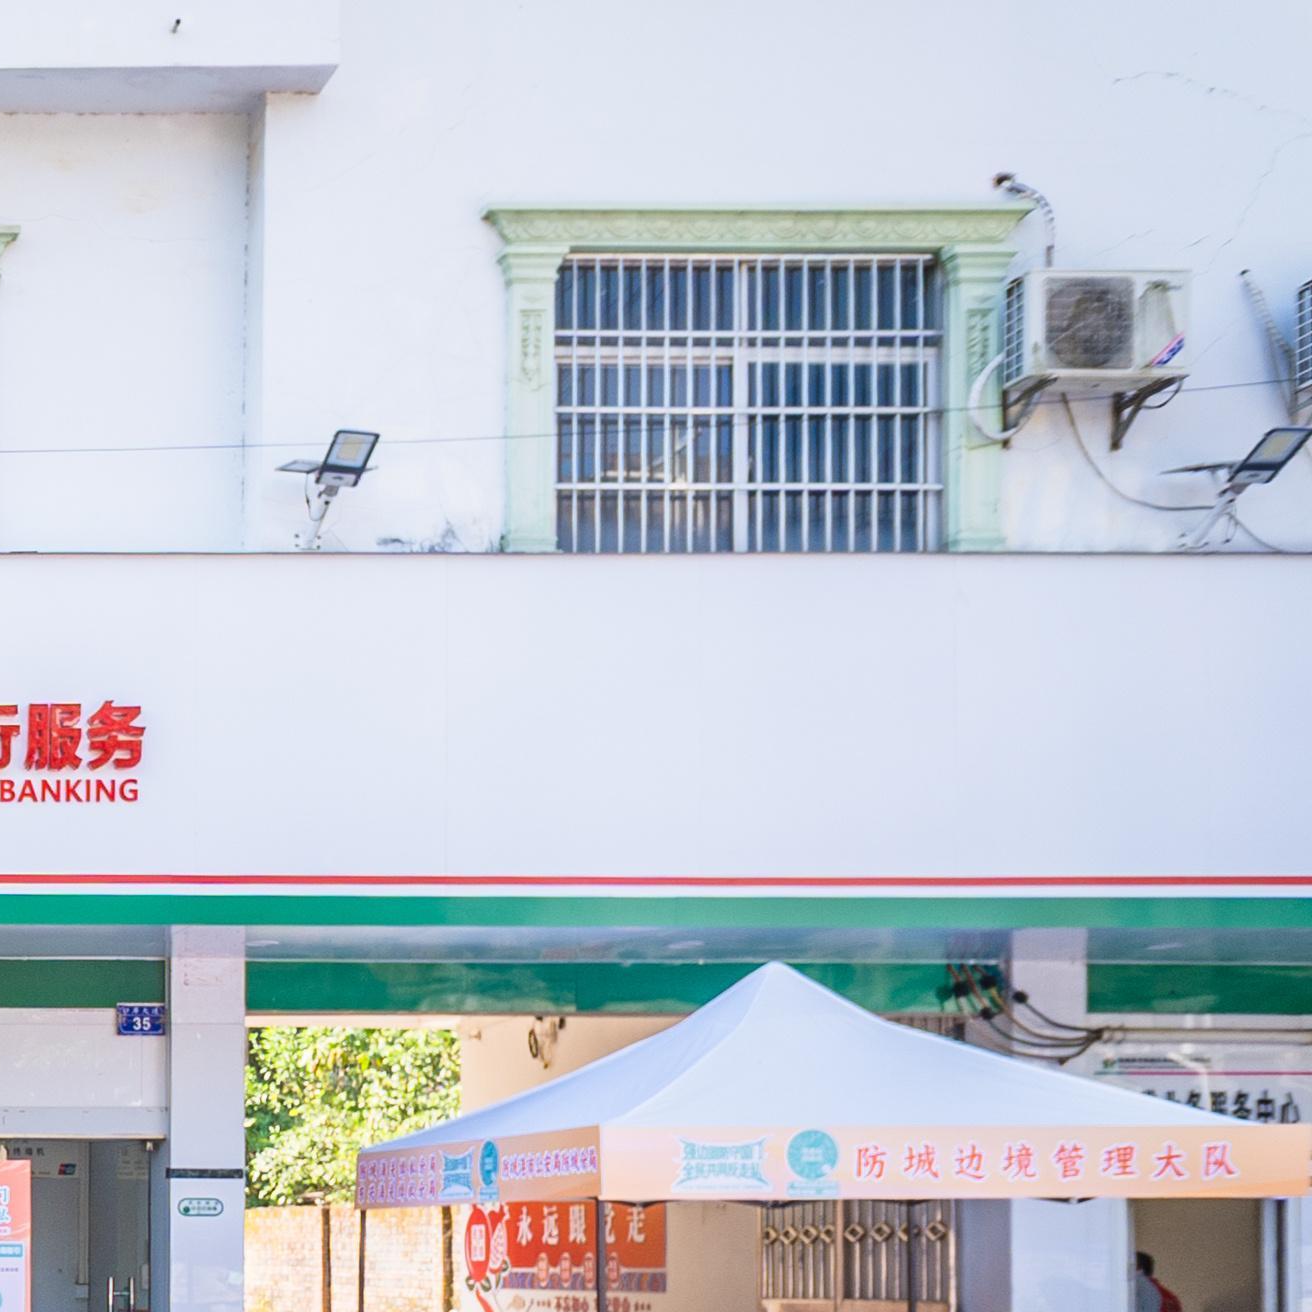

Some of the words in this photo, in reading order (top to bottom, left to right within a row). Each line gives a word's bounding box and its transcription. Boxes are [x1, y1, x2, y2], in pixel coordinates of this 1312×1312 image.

[0, 780, 140, 803] BANKING
[132, 1017, 151, 1031] 35
[856, 1143, 1238, 1180] 防城边境管理大队
